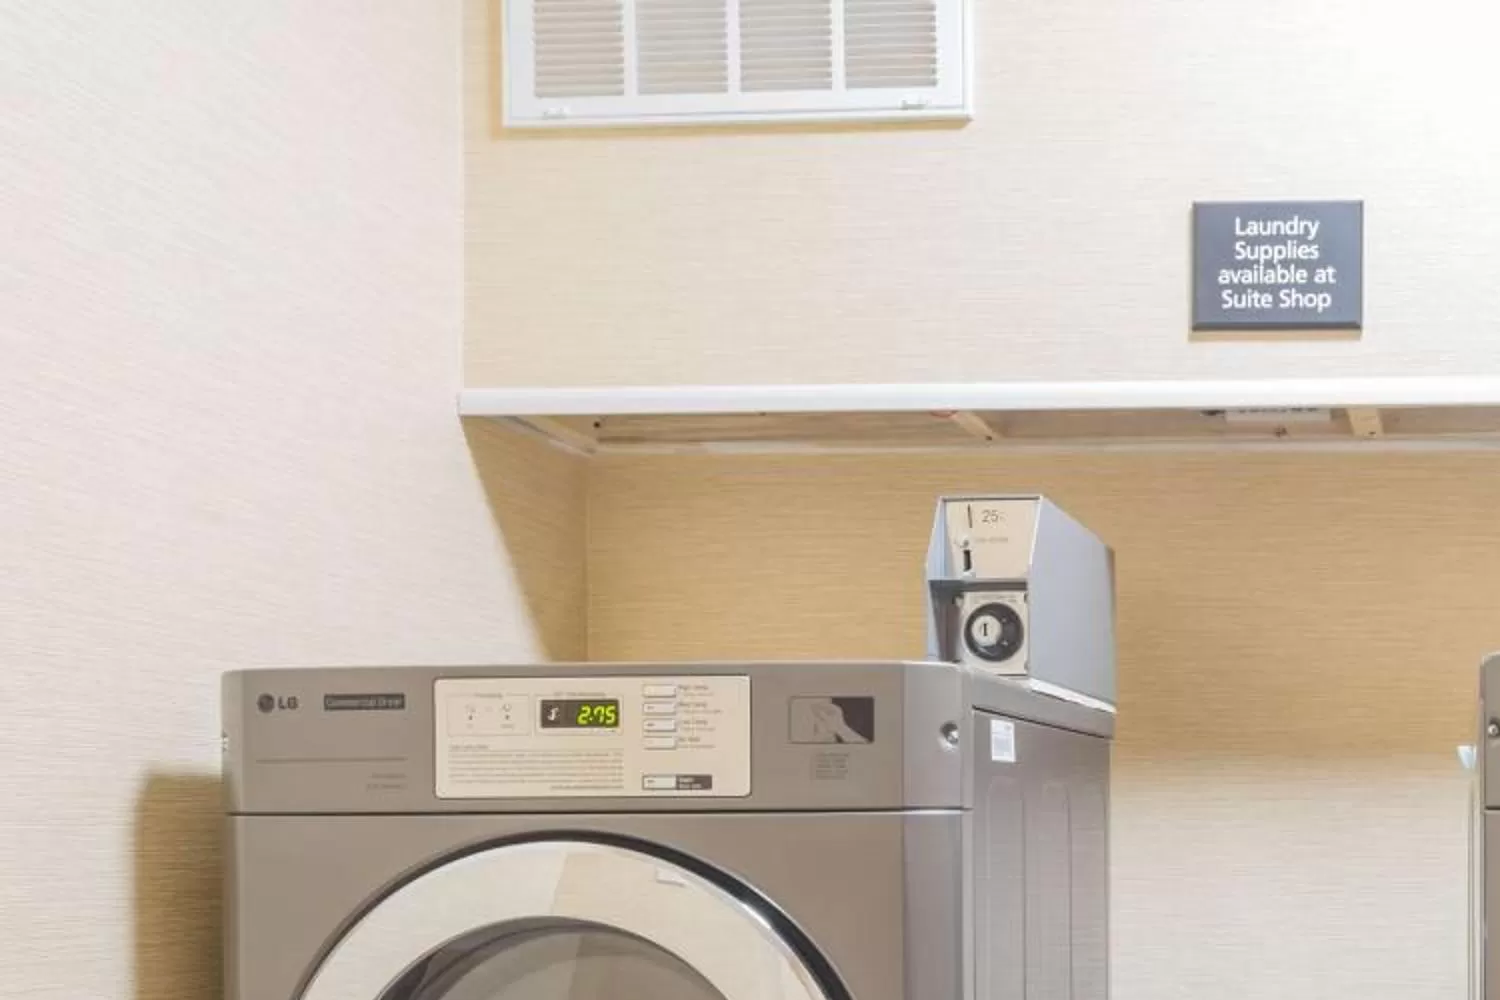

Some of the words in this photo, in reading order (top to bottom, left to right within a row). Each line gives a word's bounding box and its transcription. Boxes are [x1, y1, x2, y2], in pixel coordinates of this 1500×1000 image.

[1234, 215, 1320, 241] Laundry
[1234, 240, 1320, 264] Supplies
[1217, 264, 1309, 285] available
[1313, 266, 1337, 284] at
[1221, 288, 1273, 309] Suite
[1279, 288, 1332, 313] Shop
[277, 695, 299, 711] LG
[577, 705, 616, 725] 2.75
